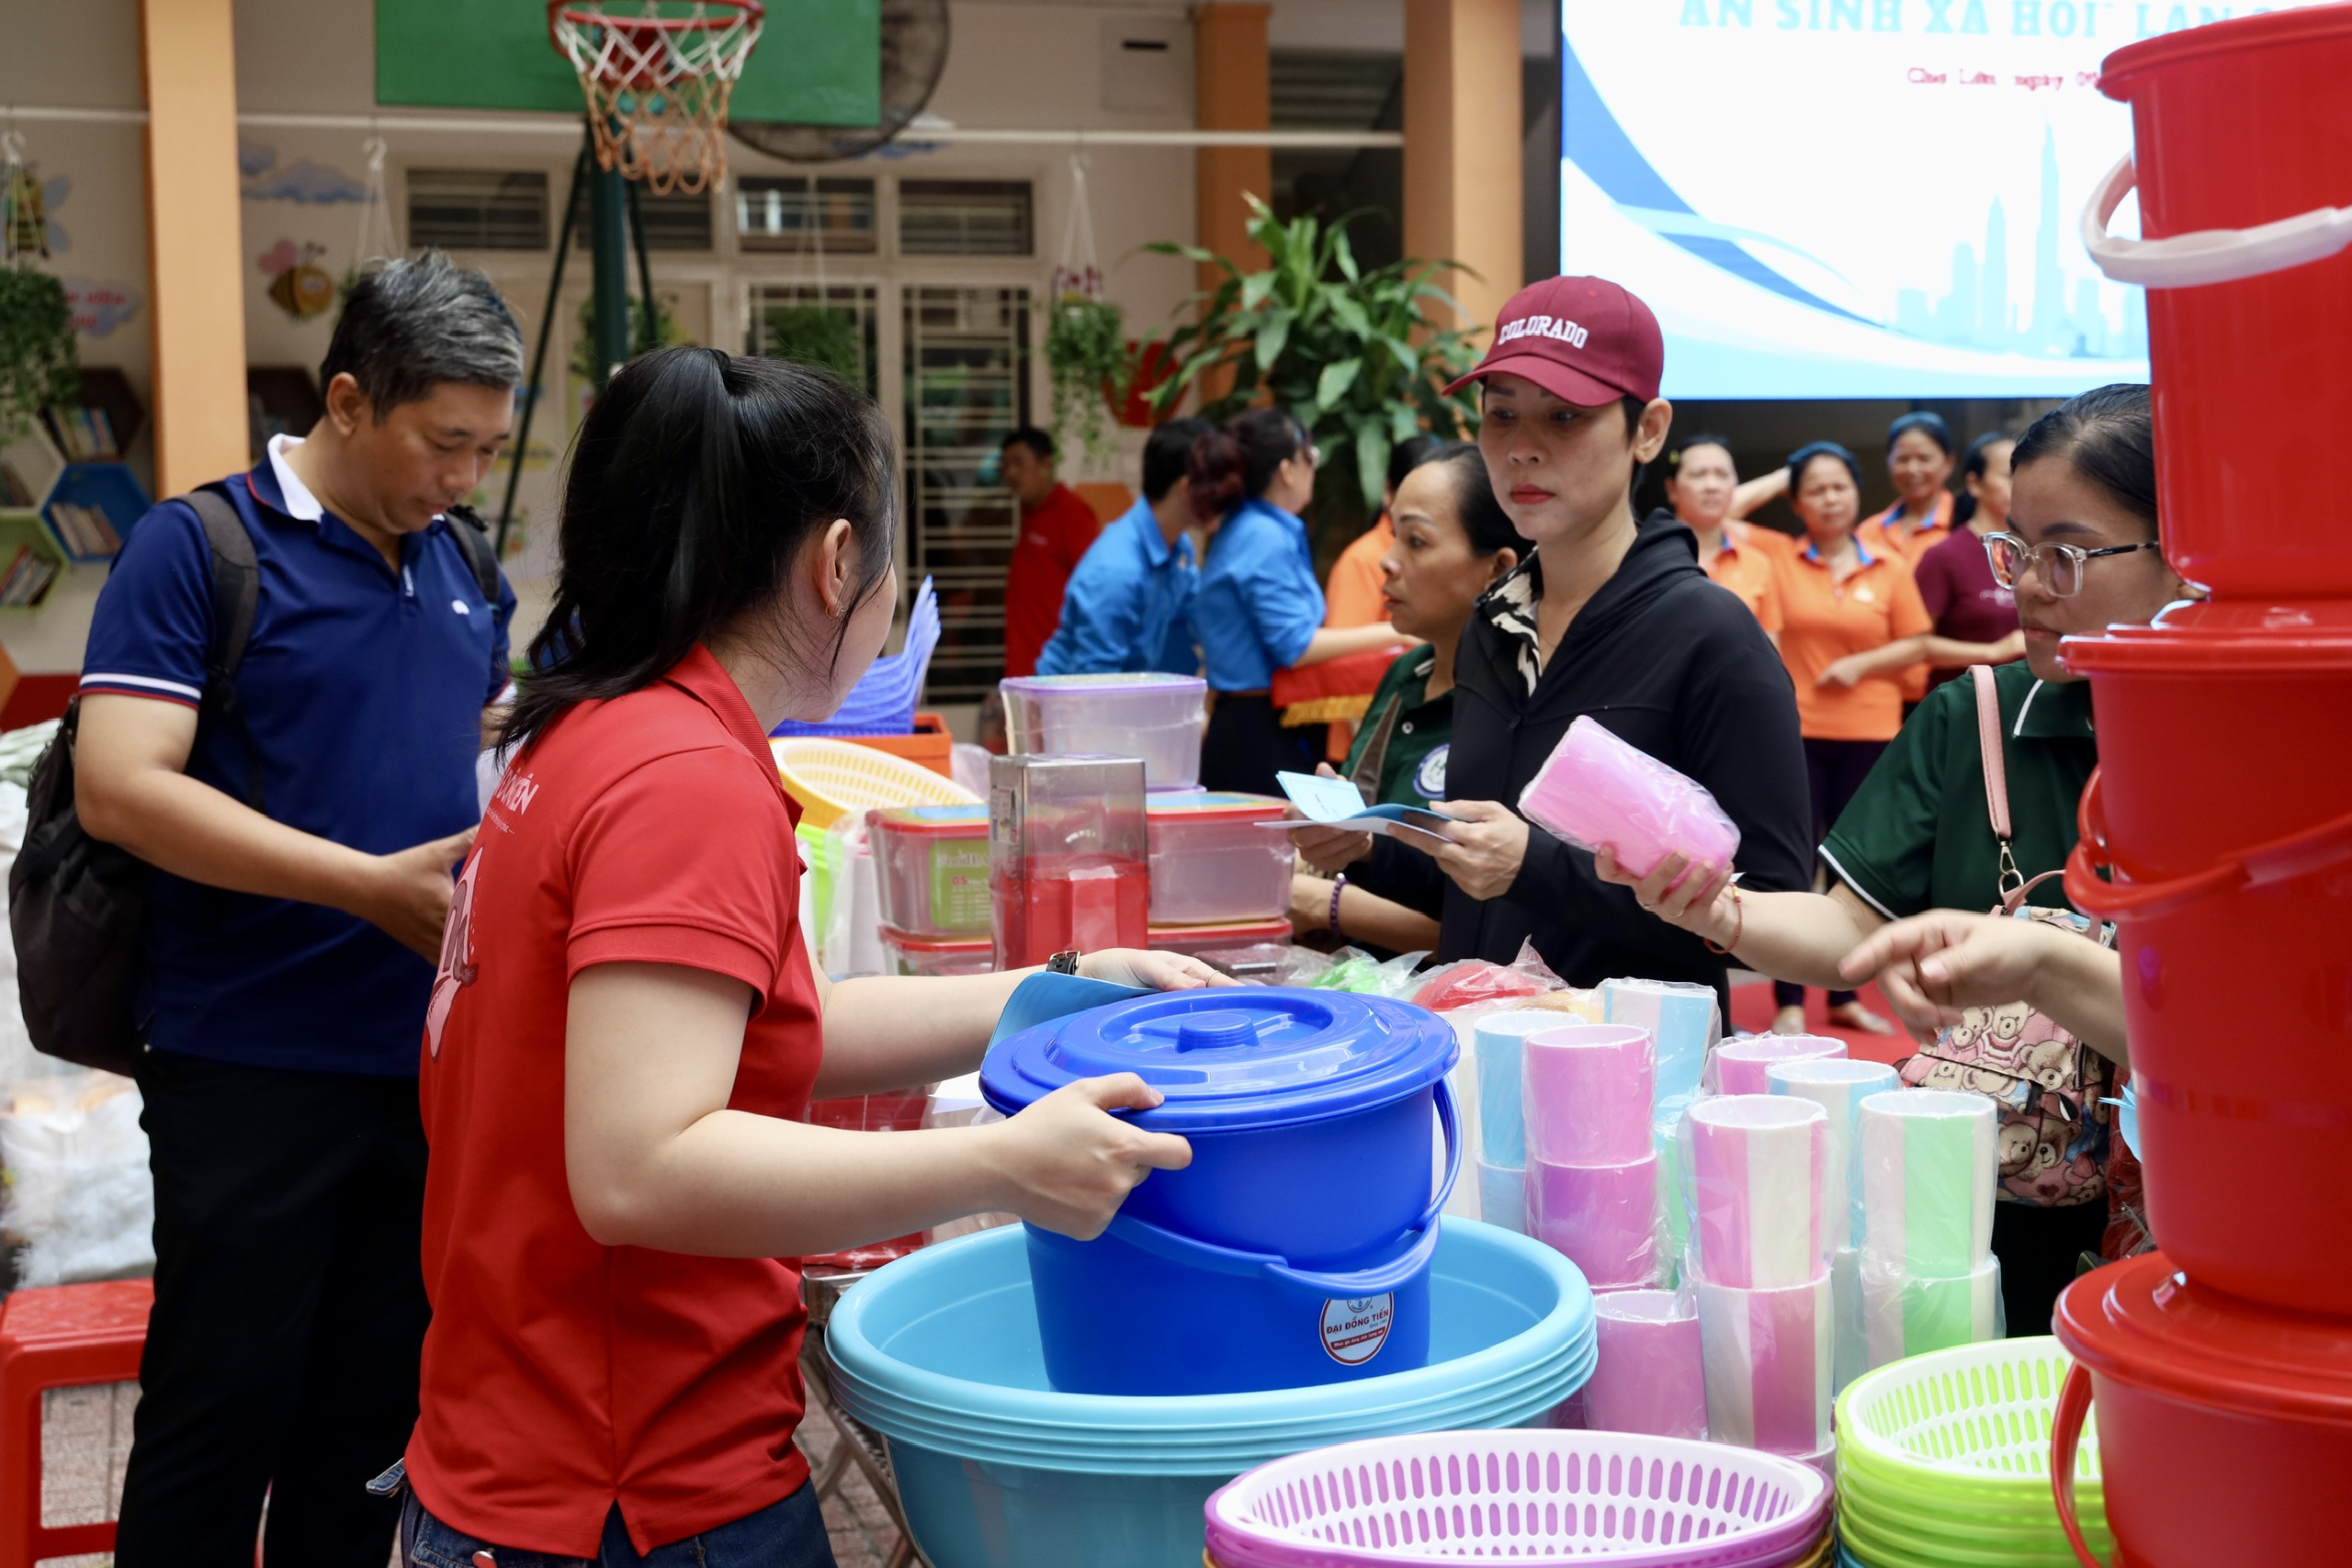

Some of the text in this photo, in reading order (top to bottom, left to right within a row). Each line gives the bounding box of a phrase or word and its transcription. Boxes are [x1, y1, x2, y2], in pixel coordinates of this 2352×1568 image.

[1498, 315, 1589, 349] COLORADO
[1326, 1324, 1342, 1335] ĐẠI
[1372, 1306, 1389, 1323] TIẾN
